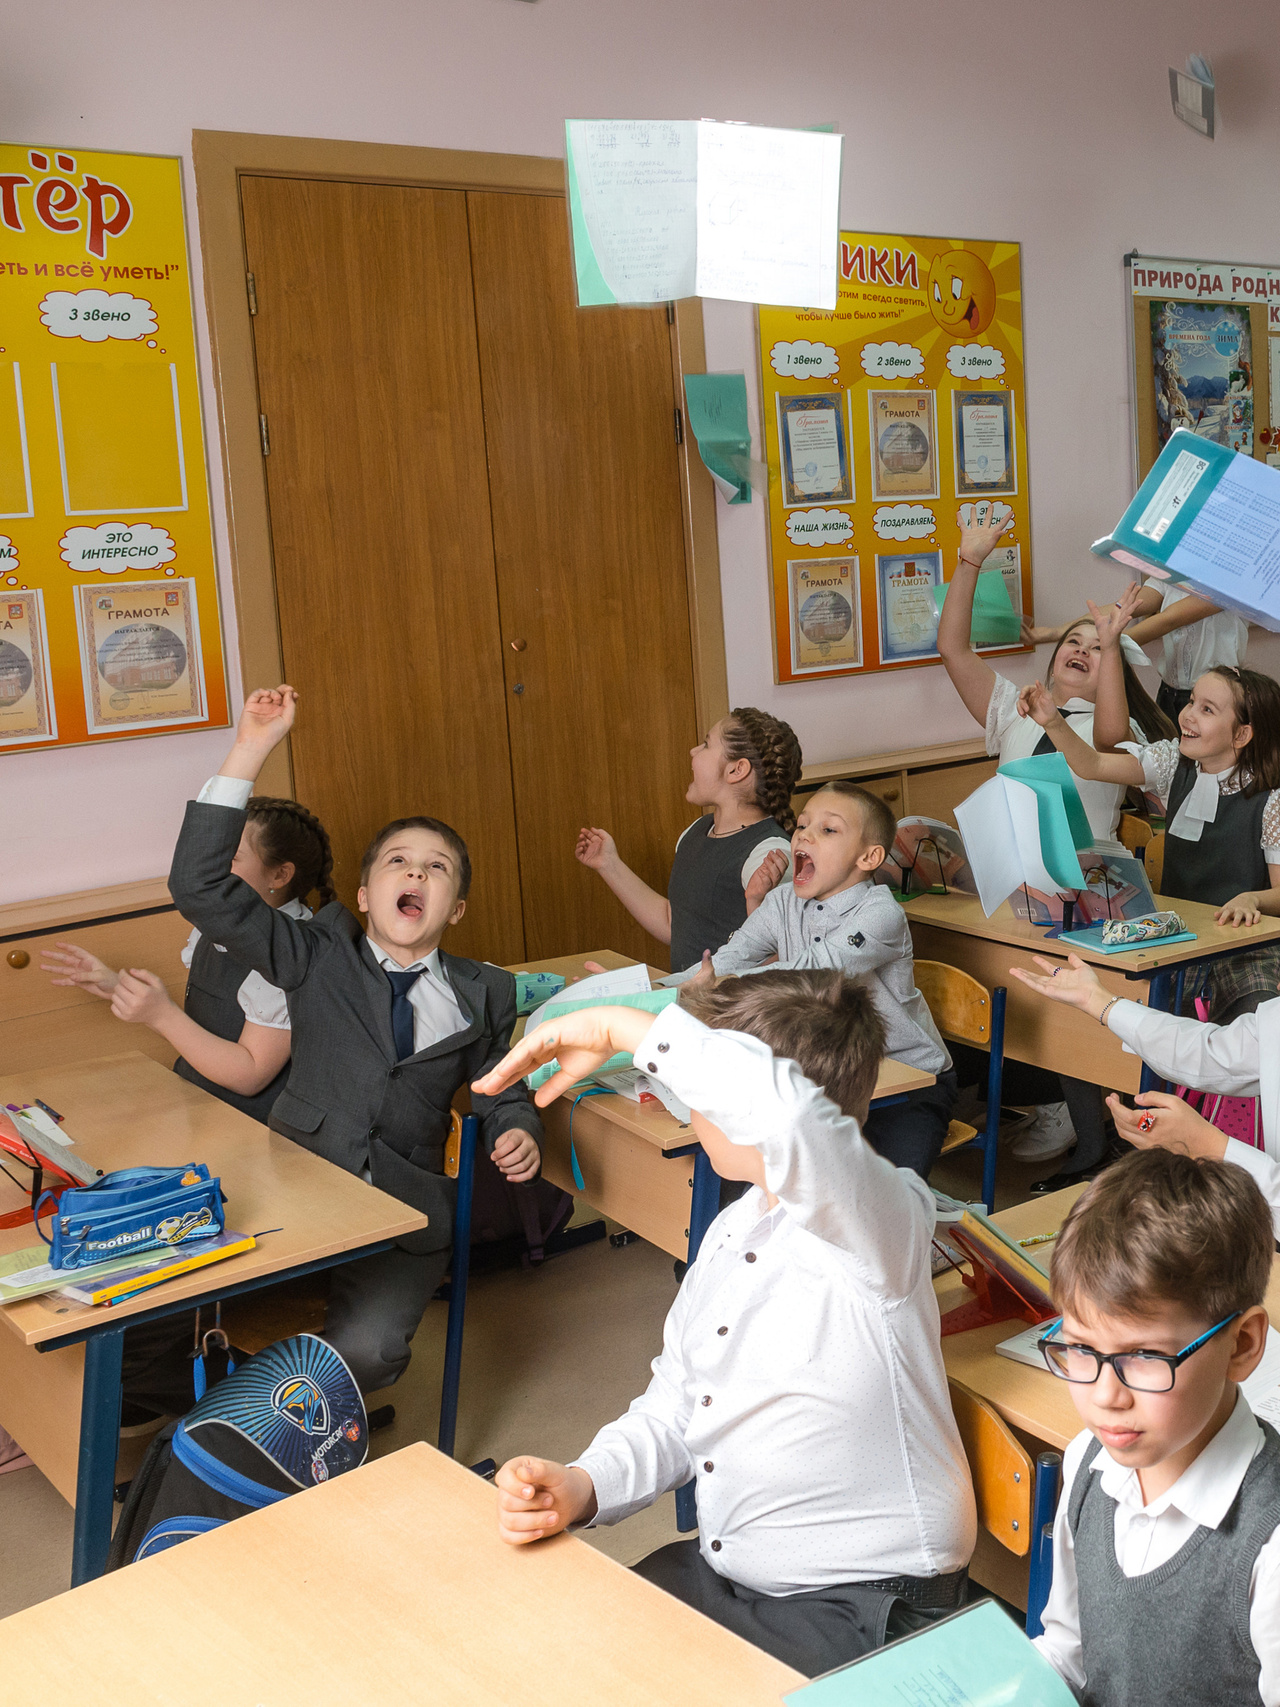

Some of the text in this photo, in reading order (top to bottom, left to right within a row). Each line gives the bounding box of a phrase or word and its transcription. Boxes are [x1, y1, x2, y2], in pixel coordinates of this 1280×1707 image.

[35, 264, 49, 277] и
[54, 261, 95, 278] всё
[1133, 269, 1224, 295] ПРИРОДА
[862, 293, 892, 304] всегда
[894, 297, 928, 308] светить,
[69, 308, 131, 322] 3 звено
[795, 313, 823, 323] чтобы
[824, 312, 852, 323] лучше
[854, 309, 876, 320] было
[1168, 333, 1195, 341] ВРЕМЕНА
[1216, 335, 1239, 343] ЗИМА
[786, 354, 822, 366] 1 звено
[877, 356, 911, 367] 2 звено
[960, 357, 993, 367] 3 звено
[885, 410, 920, 419] ГРАМОТА
[1196, 460, 1207, 471] BG
[794, 521, 849, 533] НАША ЖИЗНЬ
[880, 517, 934, 528] ПОЗДРАВЛЯЕМ
[105, 532, 133, 544] ЭТО
[81, 546, 159, 560] ИНТЕРЕСНО
[805, 578, 843, 588] ГРАМОТА
[891, 577, 929, 588] ГРАМОТА
[108, 607, 170, 620] ГРАМОТА
[87, 1225, 152, 1251] Football
